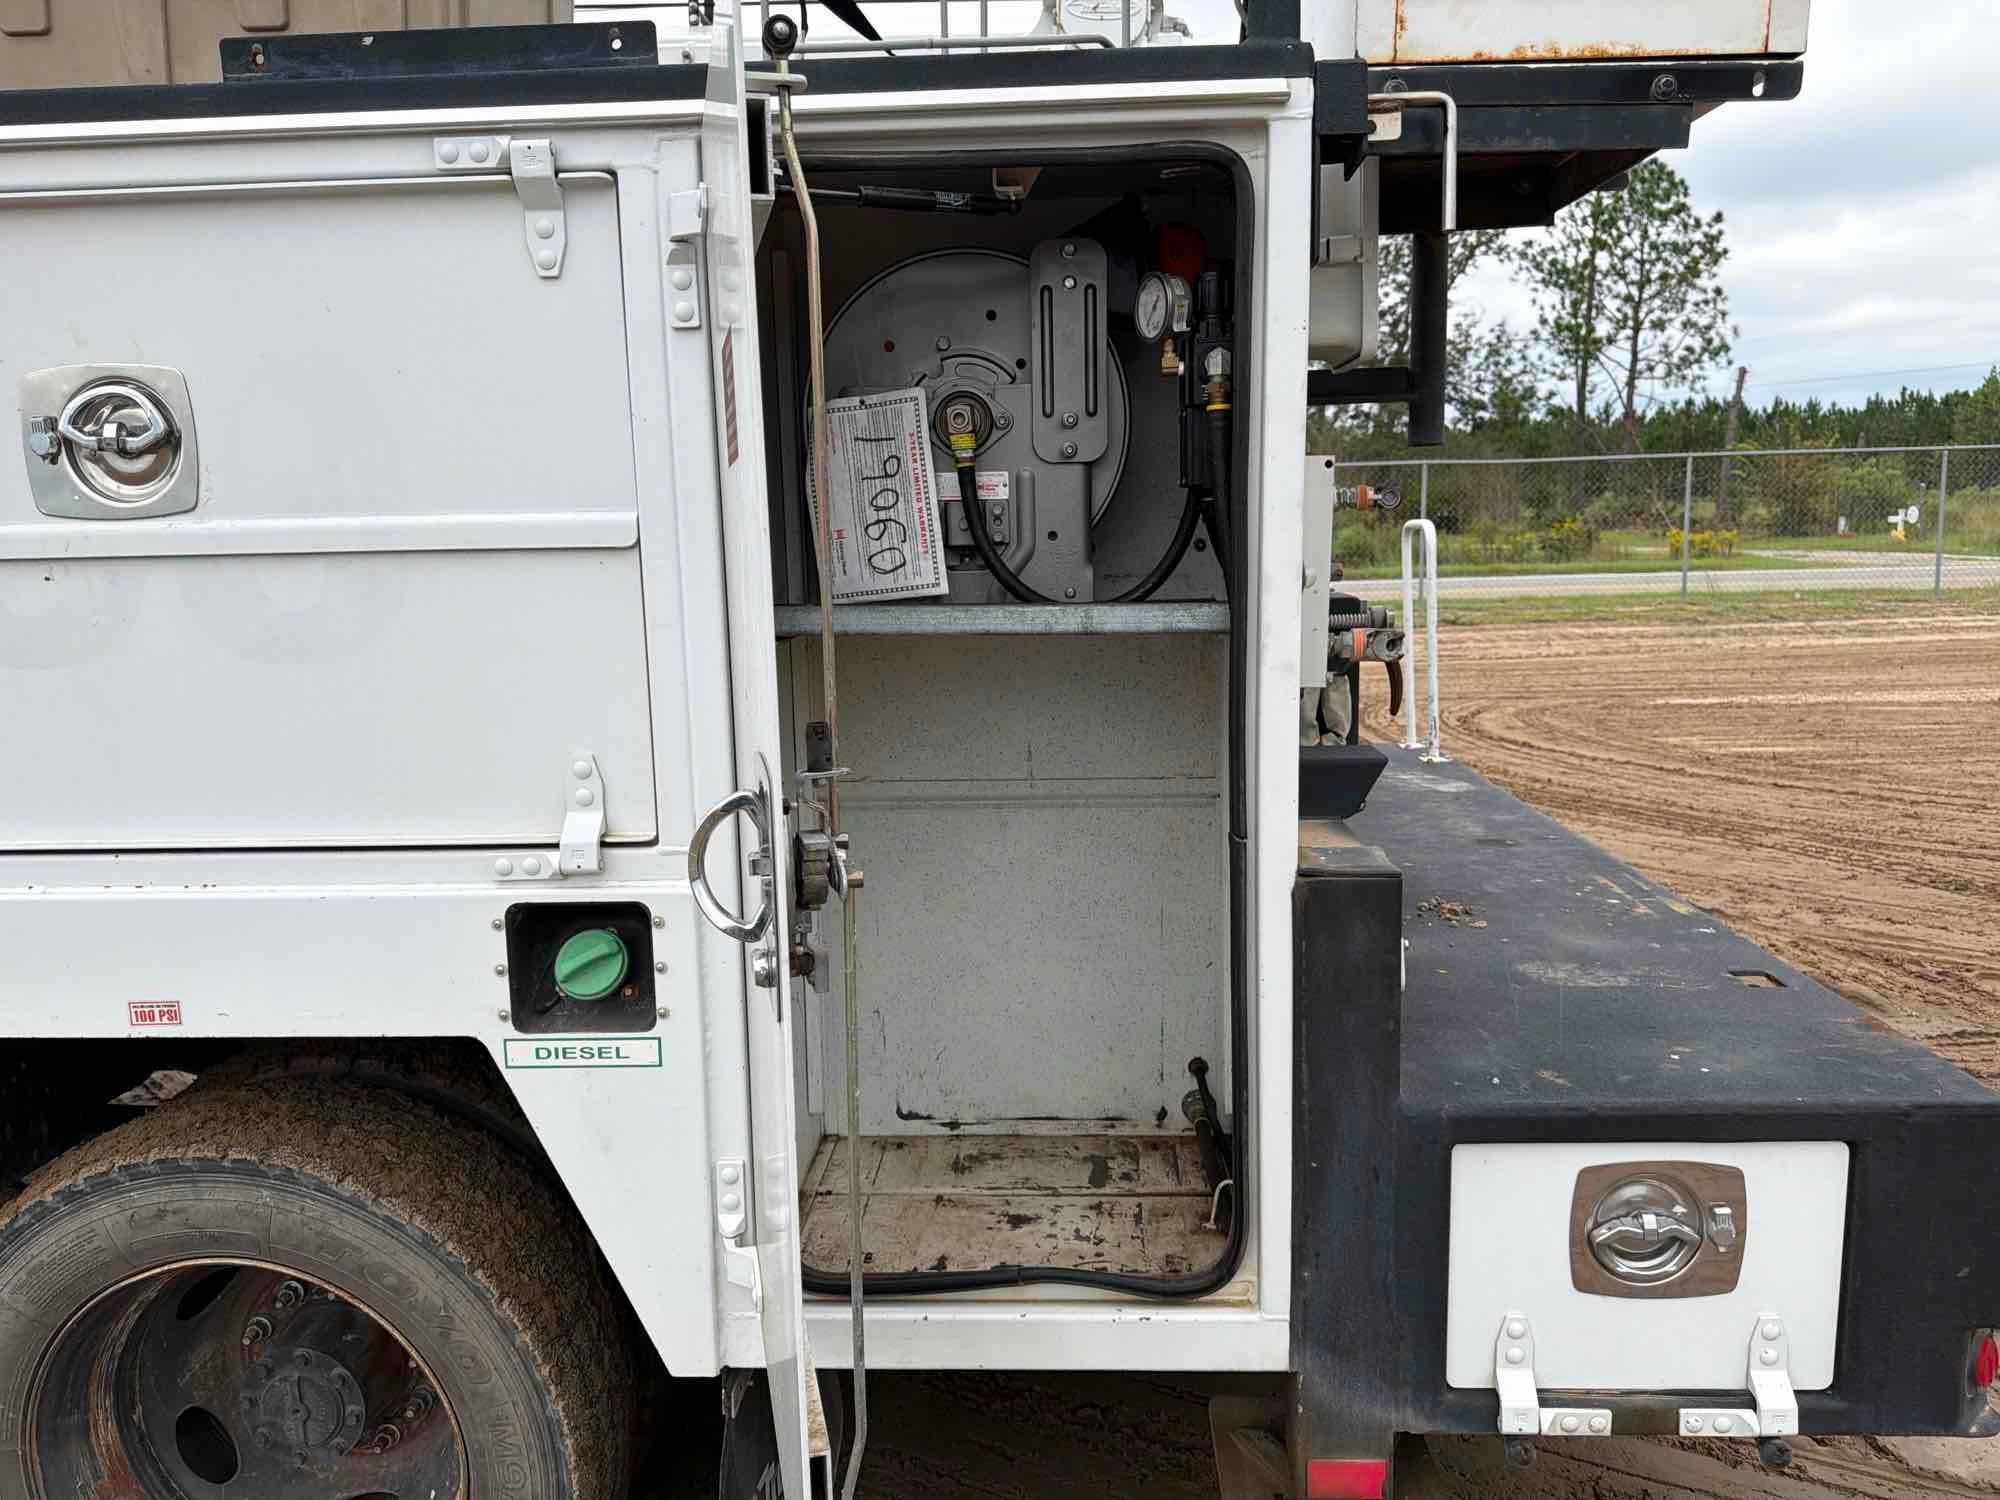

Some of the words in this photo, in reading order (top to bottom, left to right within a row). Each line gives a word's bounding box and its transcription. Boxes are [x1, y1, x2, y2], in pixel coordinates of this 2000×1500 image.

[912, 467, 922, 503] LIMITED
[853, 436, 906, 574] 19060
[134, 1009, 155, 1023] 100
[158, 1008, 178, 1022] PSI
[534, 1046, 631, 1061] DIESEL
